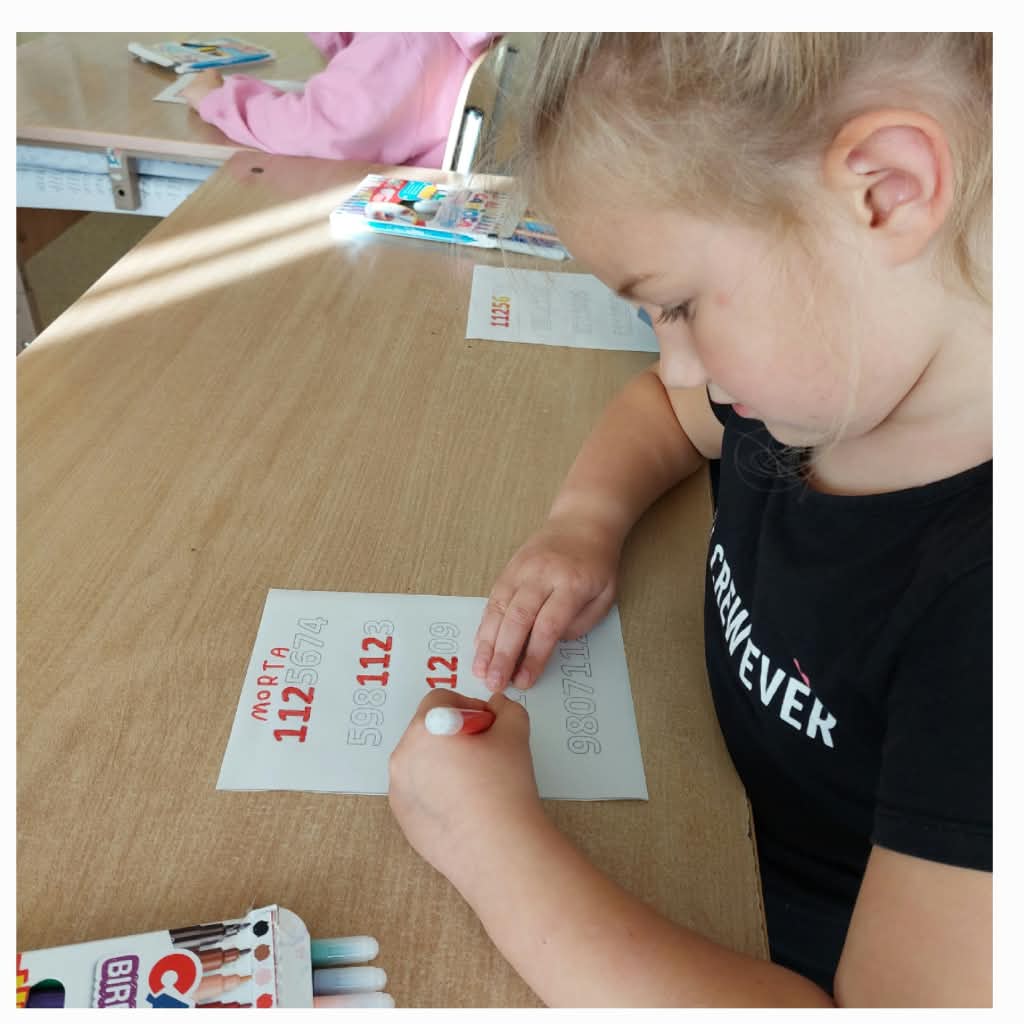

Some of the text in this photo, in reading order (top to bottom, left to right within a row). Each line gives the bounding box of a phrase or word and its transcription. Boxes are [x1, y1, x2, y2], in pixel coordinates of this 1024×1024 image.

[251, 647, 290, 721] MORTA
[273, 617, 329, 743] 1125674
[346, 619, 395, 747] 5981123
[559, 634, 602, 755] 980711
